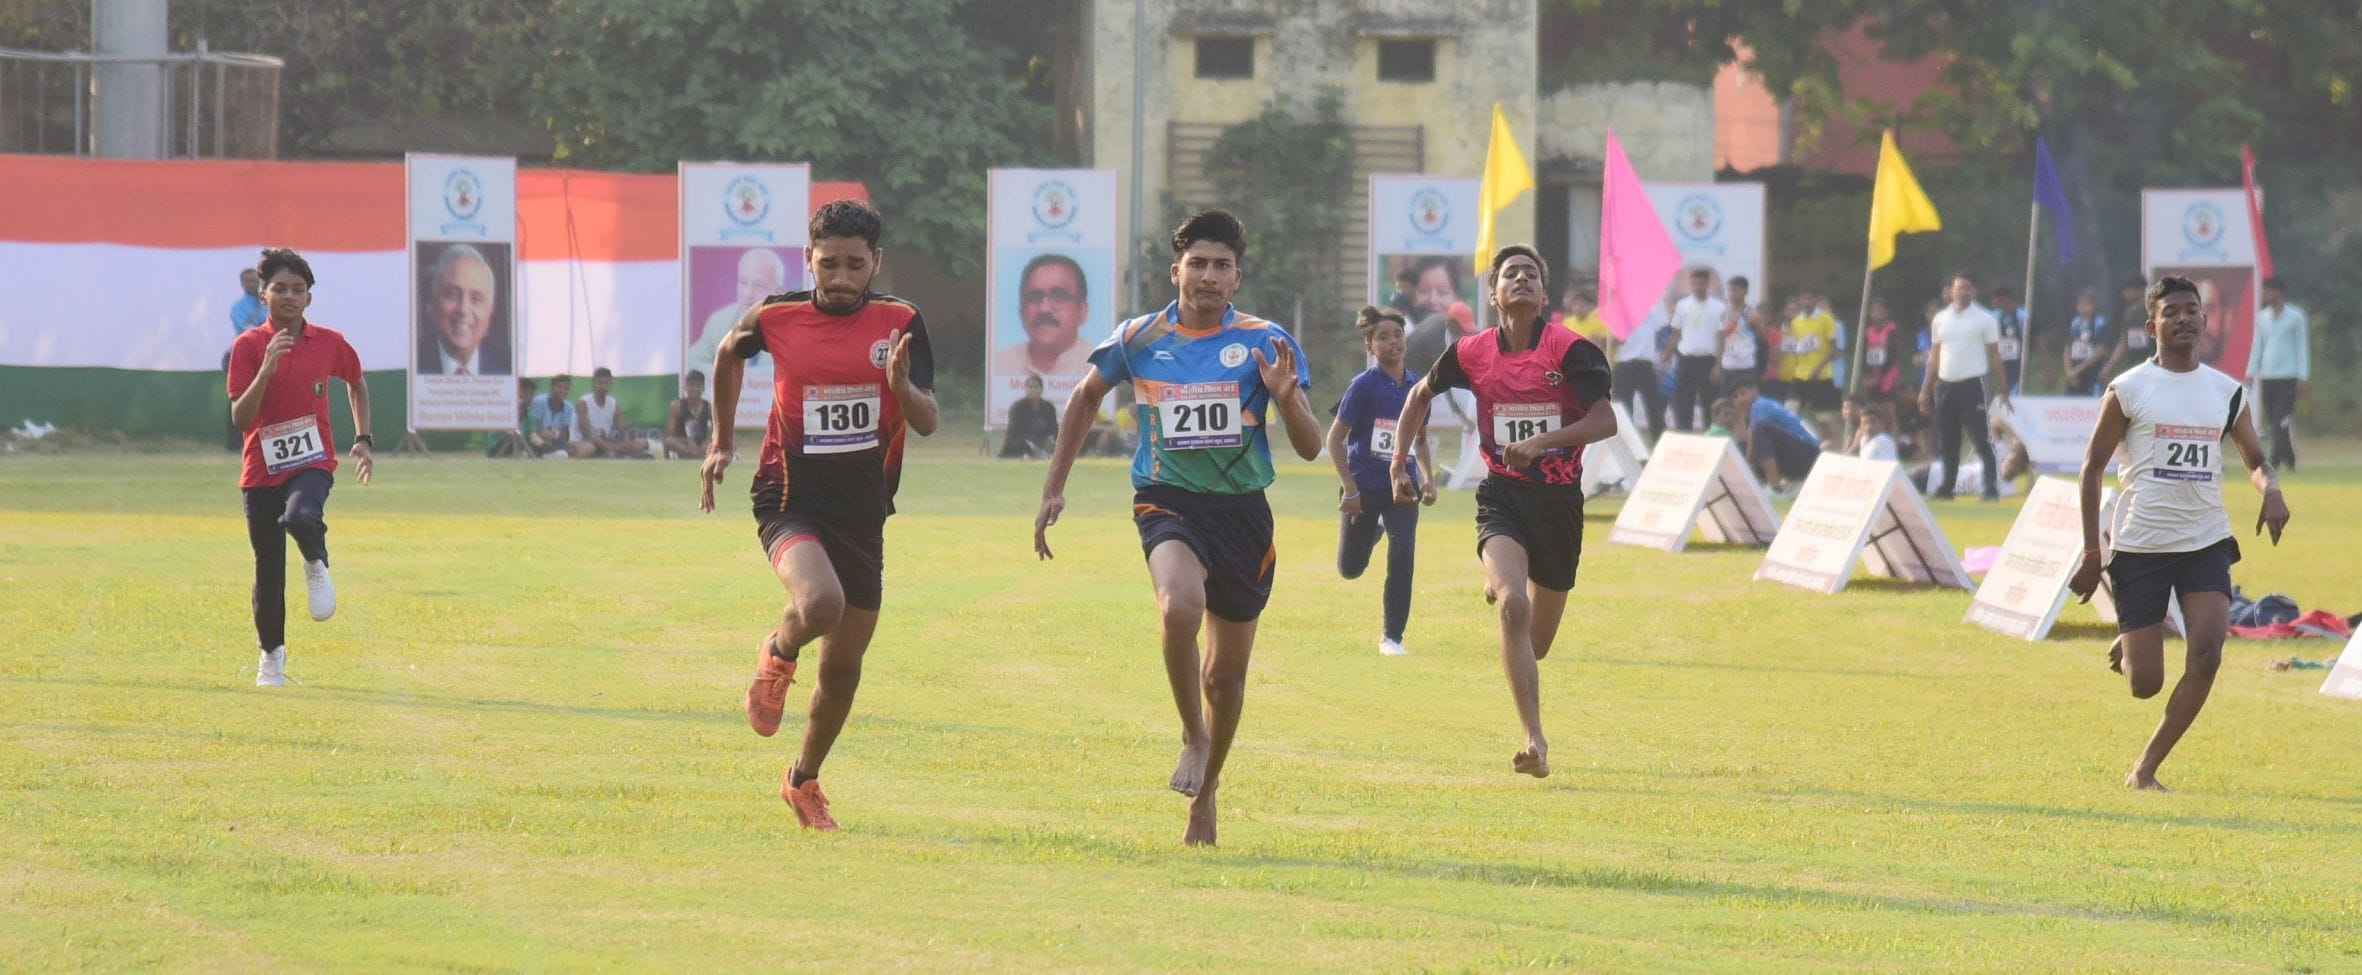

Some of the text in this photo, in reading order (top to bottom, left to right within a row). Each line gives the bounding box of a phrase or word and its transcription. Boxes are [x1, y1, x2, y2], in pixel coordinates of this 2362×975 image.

[815, 402, 869, 430] 130
[1174, 403, 1228, 432] 210
[1505, 419, 1548, 442] 181
[273, 432, 313, 459] 321
[2167, 443, 2208, 468] 241
